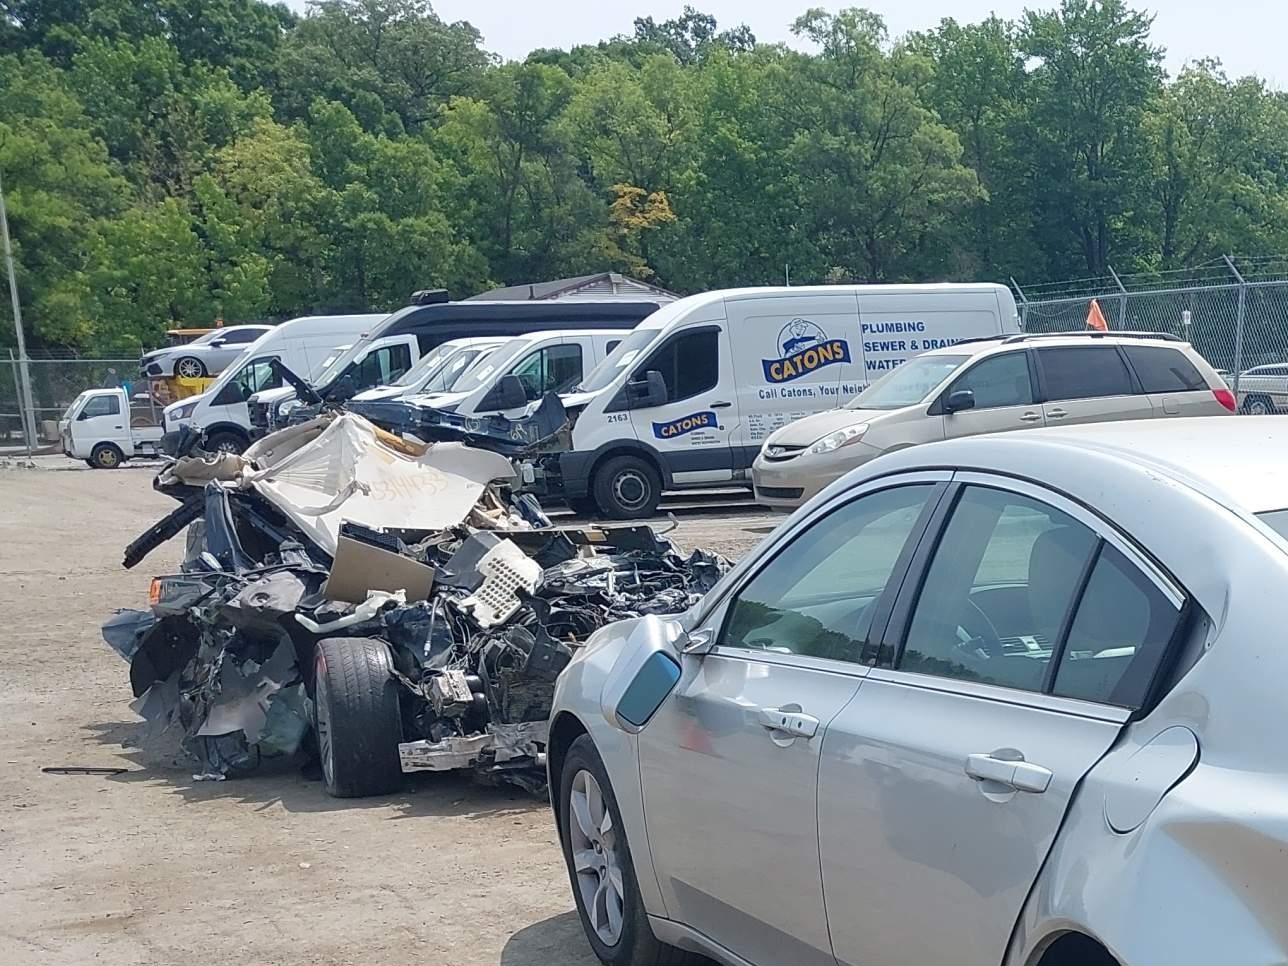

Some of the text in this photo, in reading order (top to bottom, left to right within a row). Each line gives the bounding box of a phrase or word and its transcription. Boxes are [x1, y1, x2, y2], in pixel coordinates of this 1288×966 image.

[861, 321, 925, 334] PLUMBING
[864, 340, 906, 352] SEWER
[910, 340, 919, 350] &
[769, 341, 845, 381] CATONS
[758, 388, 777, 400] Call
[780, 387, 816, 398] Catons,
[818, 384, 838, 396] Your
[607, 413, 629, 423] 2163
[660, 414, 709, 437] CATONS
